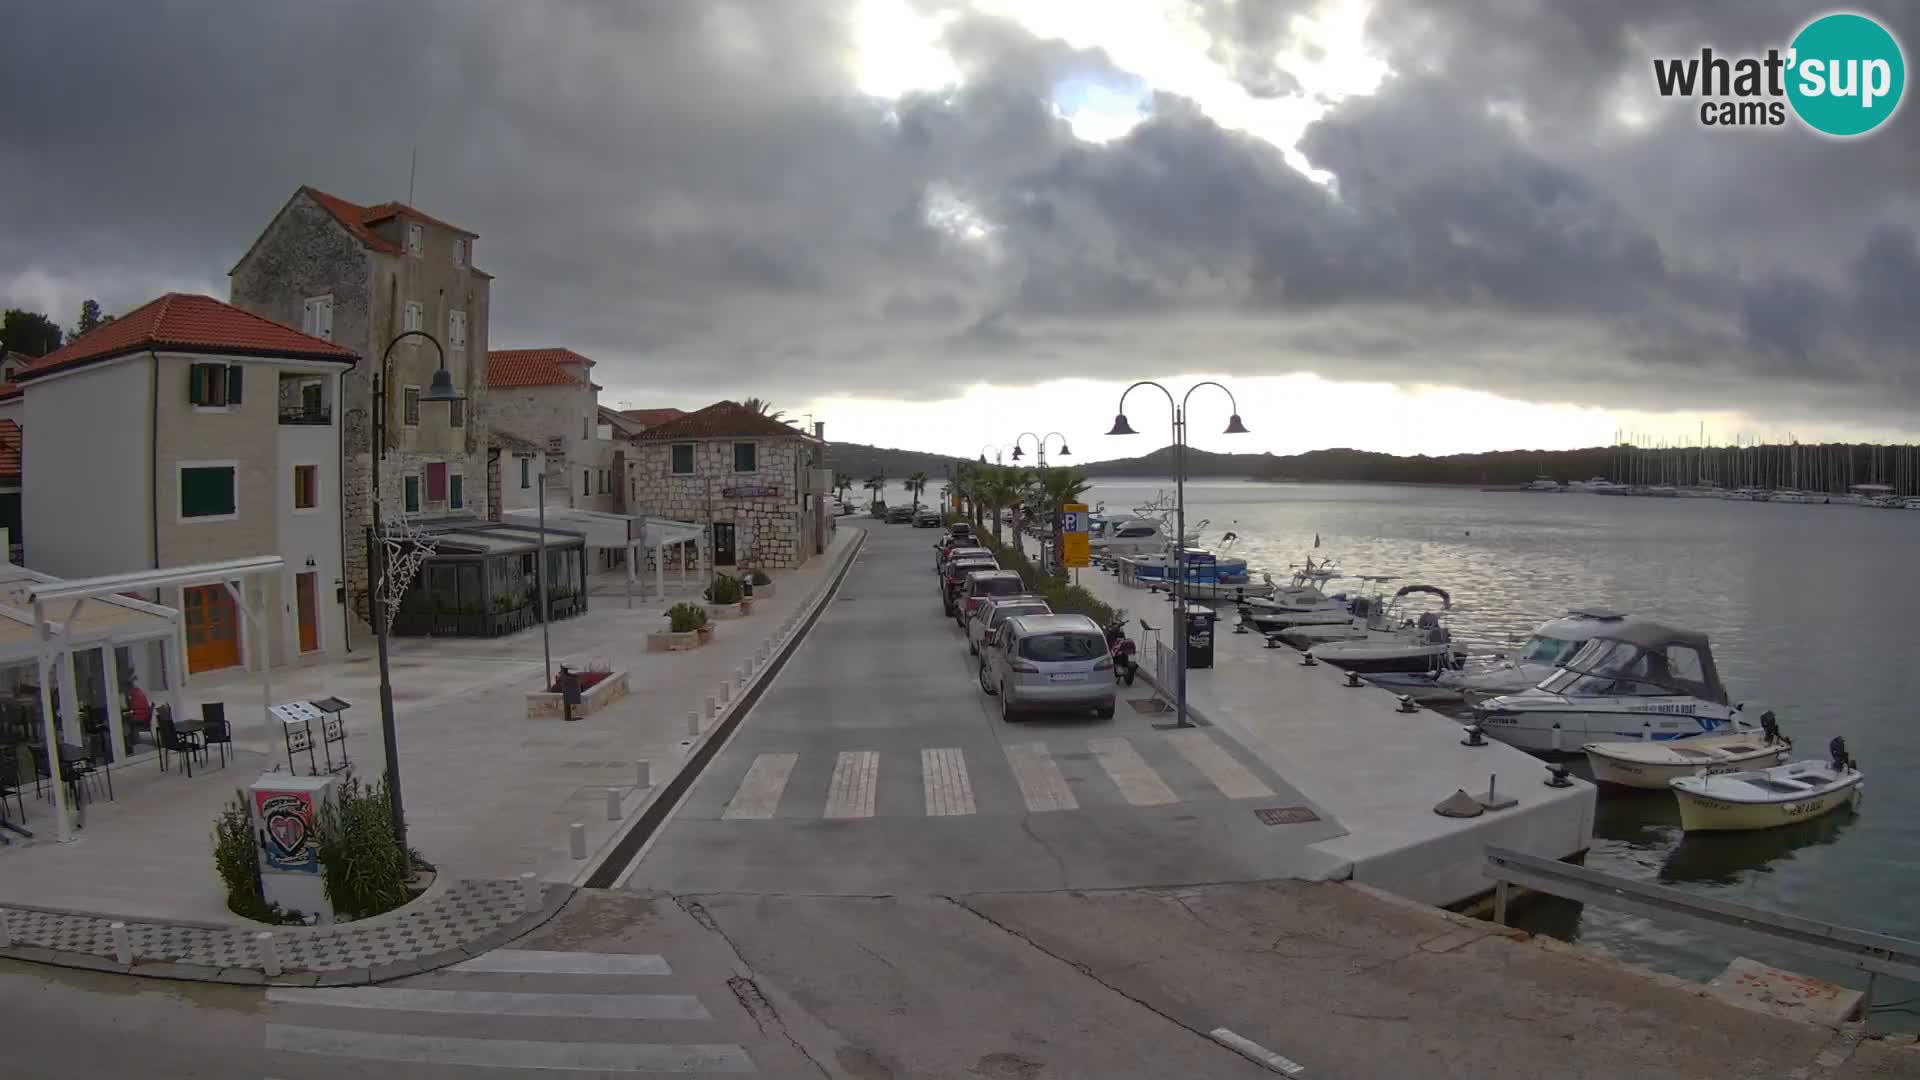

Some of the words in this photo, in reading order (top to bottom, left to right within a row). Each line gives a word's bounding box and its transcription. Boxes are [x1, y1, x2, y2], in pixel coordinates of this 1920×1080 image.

[1065, 514, 1076, 529] P
[1658, 704, 1675, 713] RENT
[1681, 704, 1696, 714] BOAT
